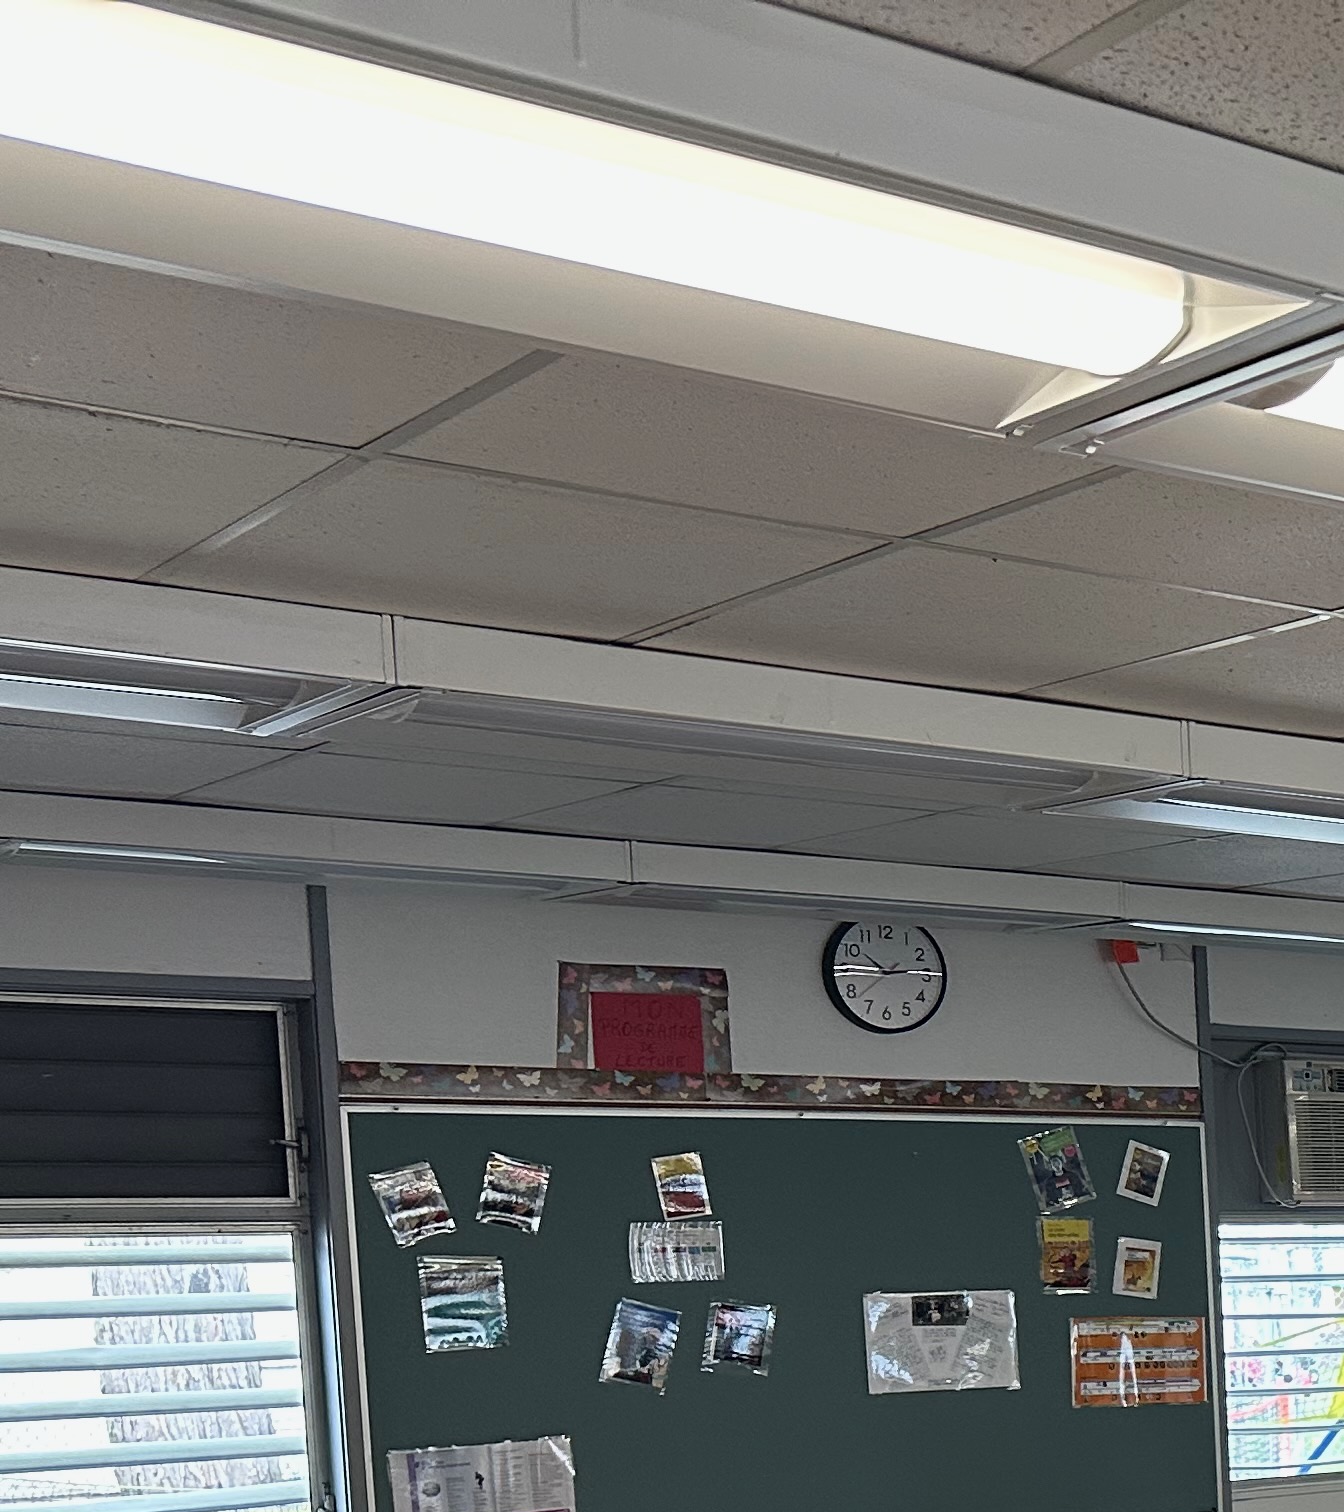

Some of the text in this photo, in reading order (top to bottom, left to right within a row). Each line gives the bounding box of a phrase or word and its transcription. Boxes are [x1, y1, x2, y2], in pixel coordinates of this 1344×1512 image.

[859, 929, 871, 944] 11
[878, 924, 893, 940] 12
[904, 931, 909, 946] 1
[843, 943, 861, 957] 10
[914, 947, 926, 962] 2
[846, 983, 857, 999] 8
[915, 989, 926, 1003] 4
[864, 999, 874, 1014] 7
[881, 1005, 892, 1021] 6
[901, 1001, 912, 1017] 5
[615, 1054, 689, 1068] LECTURE
